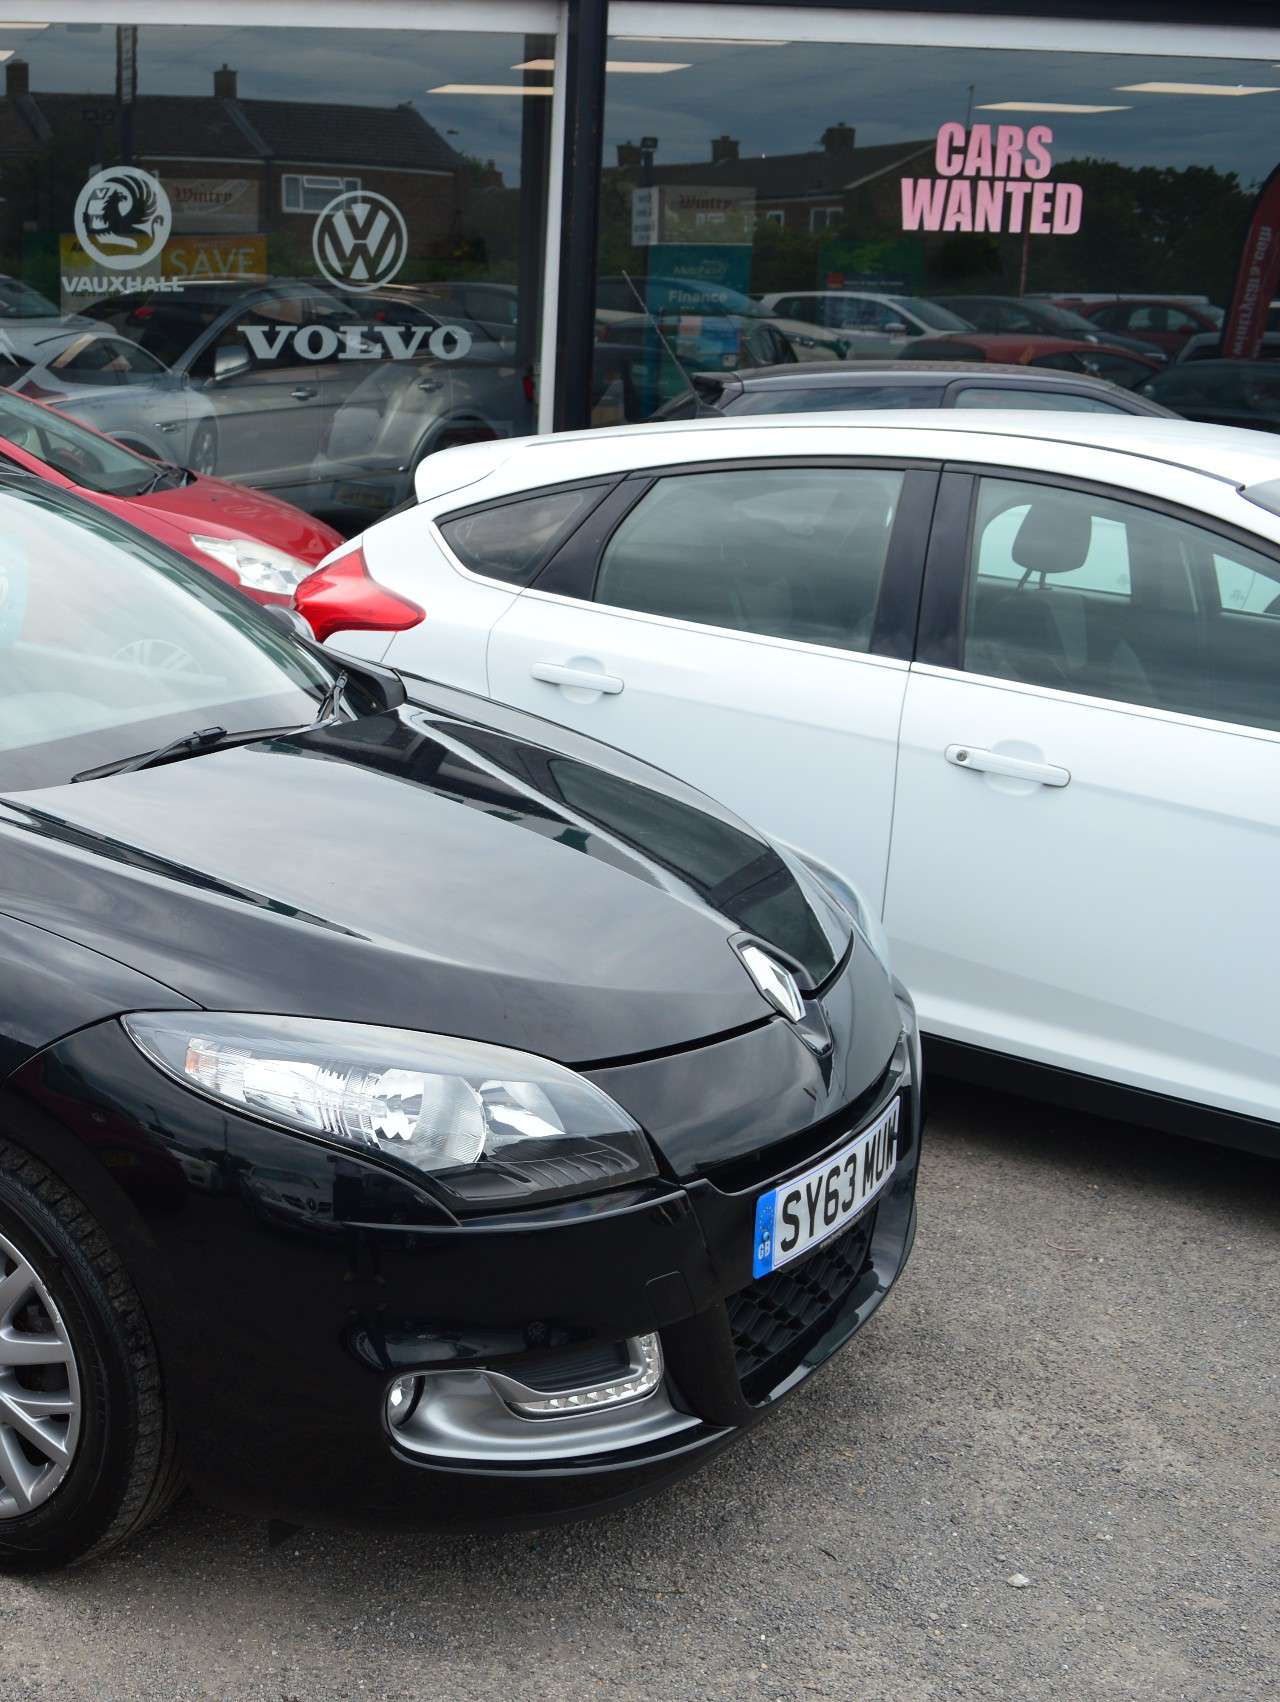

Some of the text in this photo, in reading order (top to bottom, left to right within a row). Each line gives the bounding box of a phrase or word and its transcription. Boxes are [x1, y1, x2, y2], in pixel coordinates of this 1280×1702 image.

[935, 122, 1054, 178] CARS
[900, 177, 1083, 235] WANTED
[170, 247, 256, 278] SAVE
[61, 276, 184, 292] VAUXHALL
[237, 325, 472, 361] VOLVO
[780, 1153, 857, 1252] SY63
[758, 1241, 771, 1261] GB
